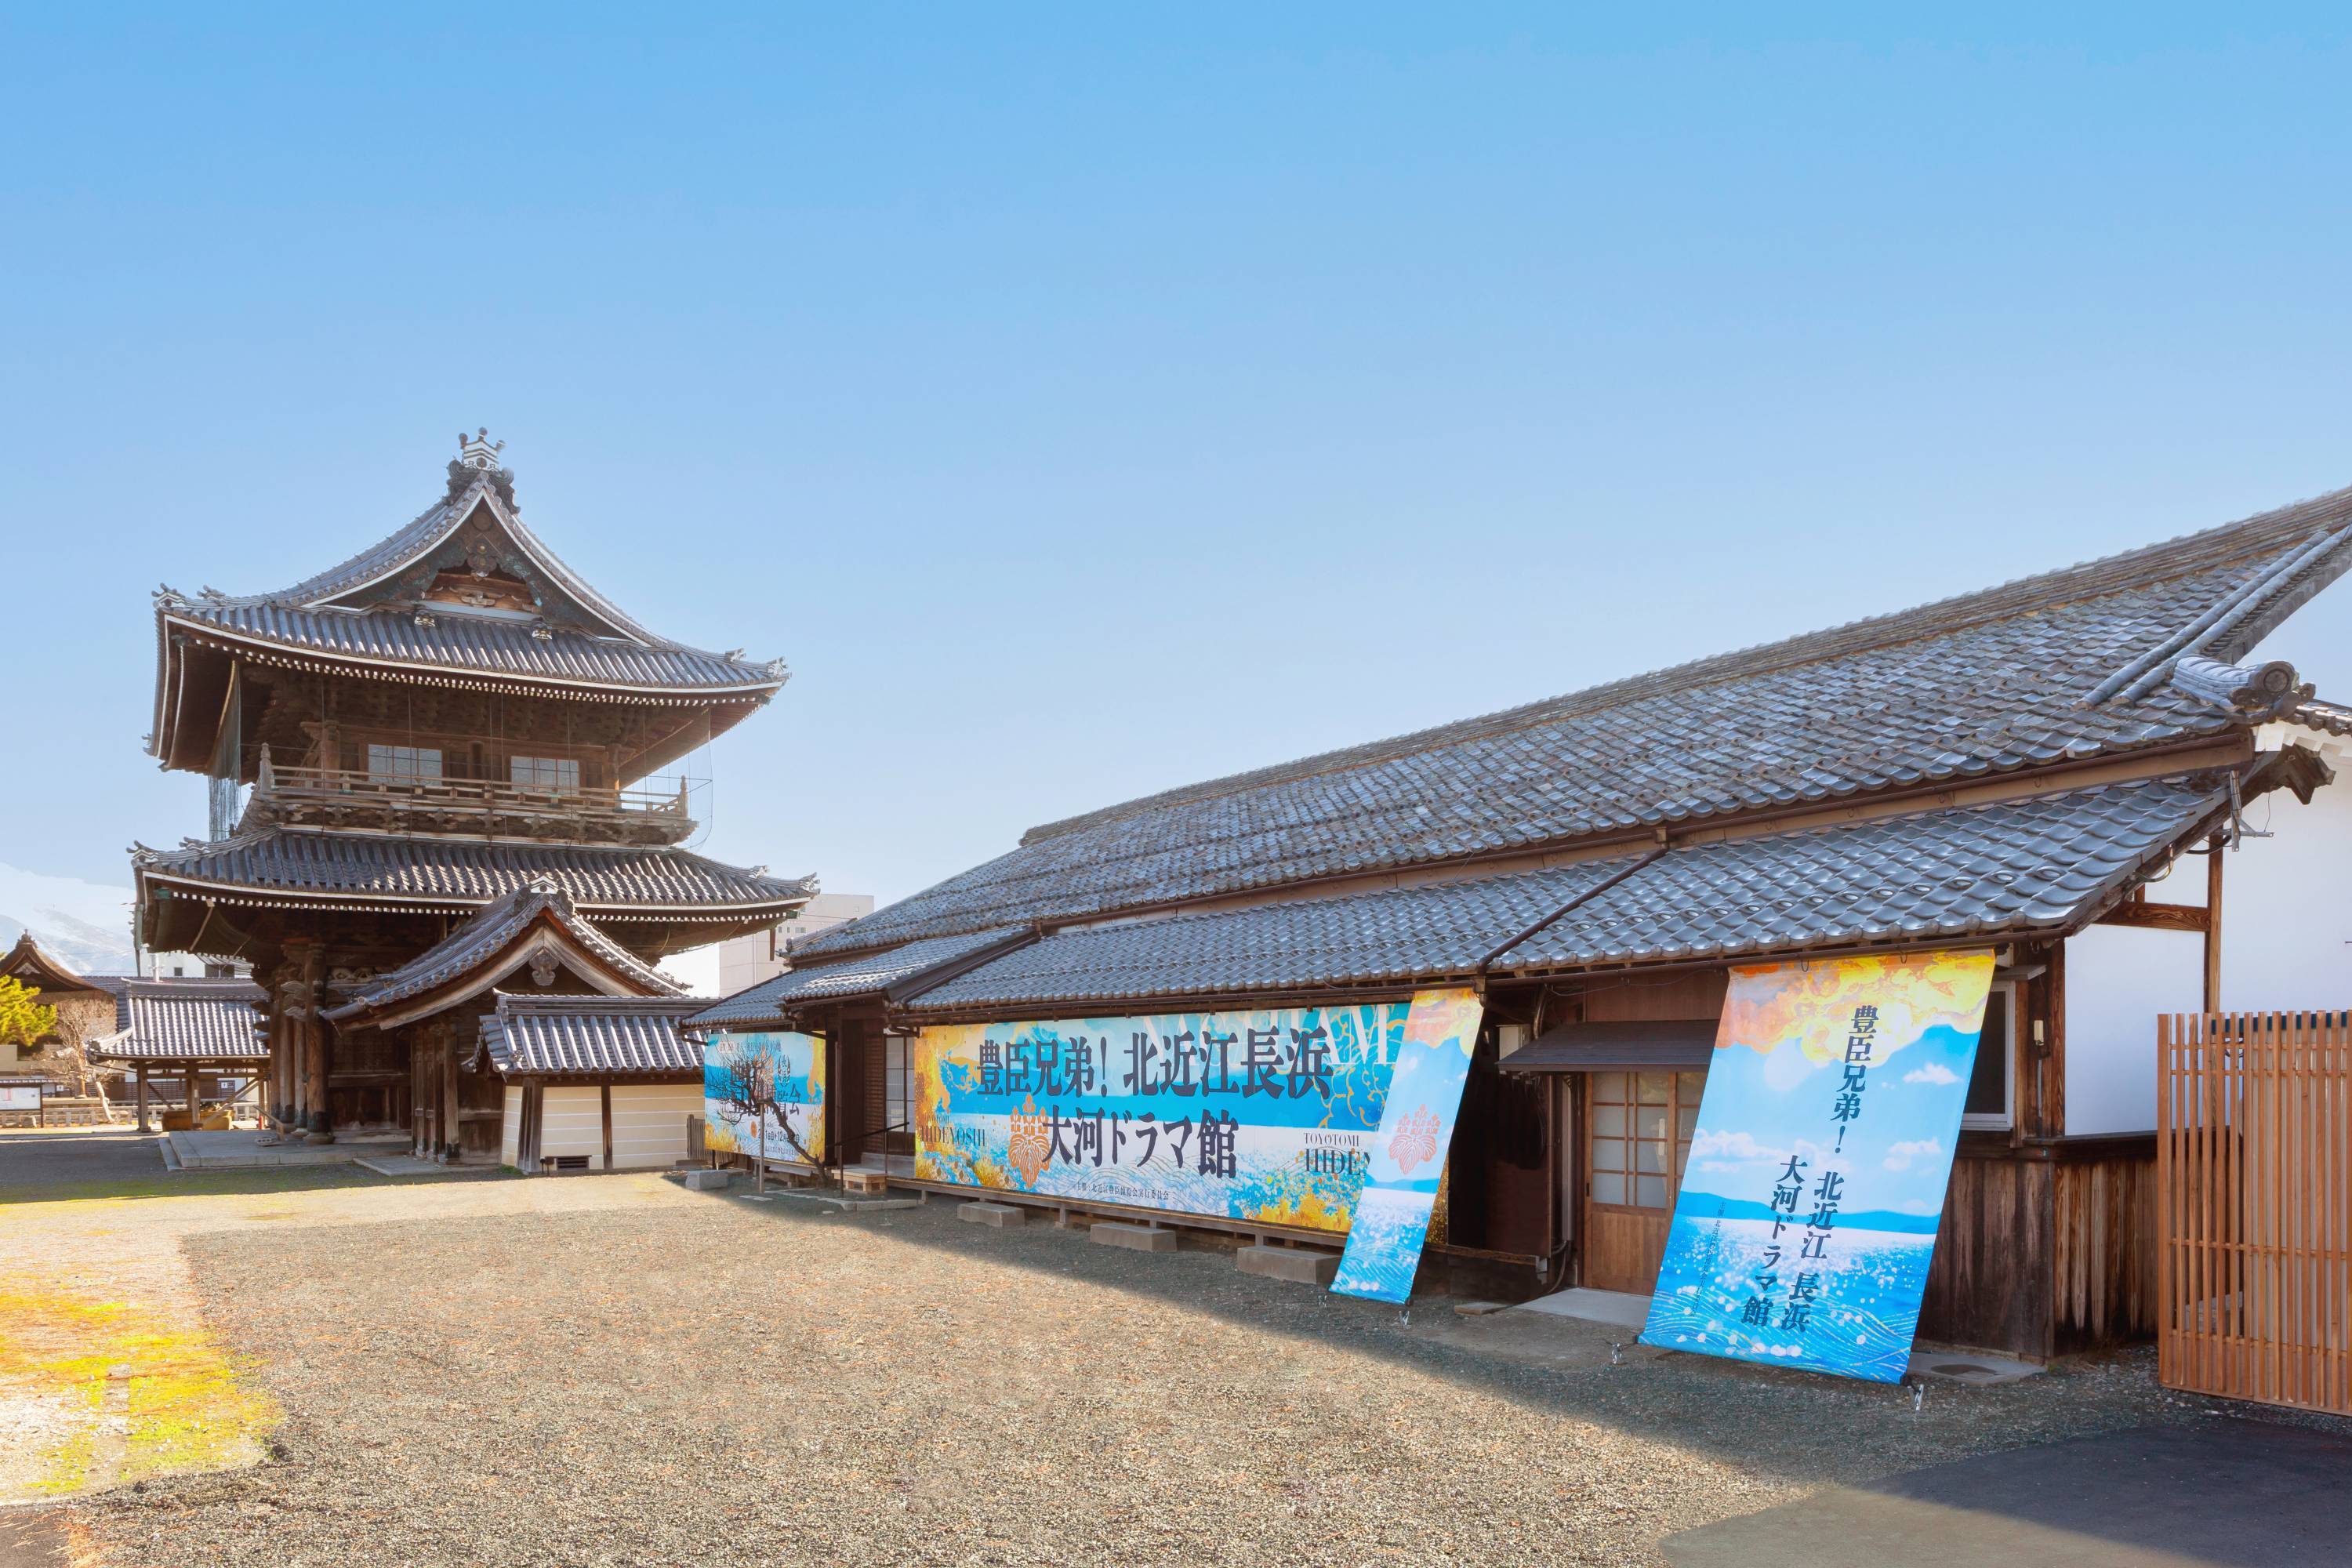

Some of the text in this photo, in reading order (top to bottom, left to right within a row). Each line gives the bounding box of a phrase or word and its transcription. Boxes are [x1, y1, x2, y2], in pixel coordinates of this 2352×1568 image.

[977, 1025, 1334, 1101] 豊臣兄弟！ 北近江長浜
[1829, 1004, 1879, 1154] 豊臣兄弟！
[1040, 1105, 1240, 1179] 大河ドラマ館
[1304, 1131, 1360, 1147] TOYOTOMI
[1740, 1155, 1808, 1327] 大河ドラマ館
